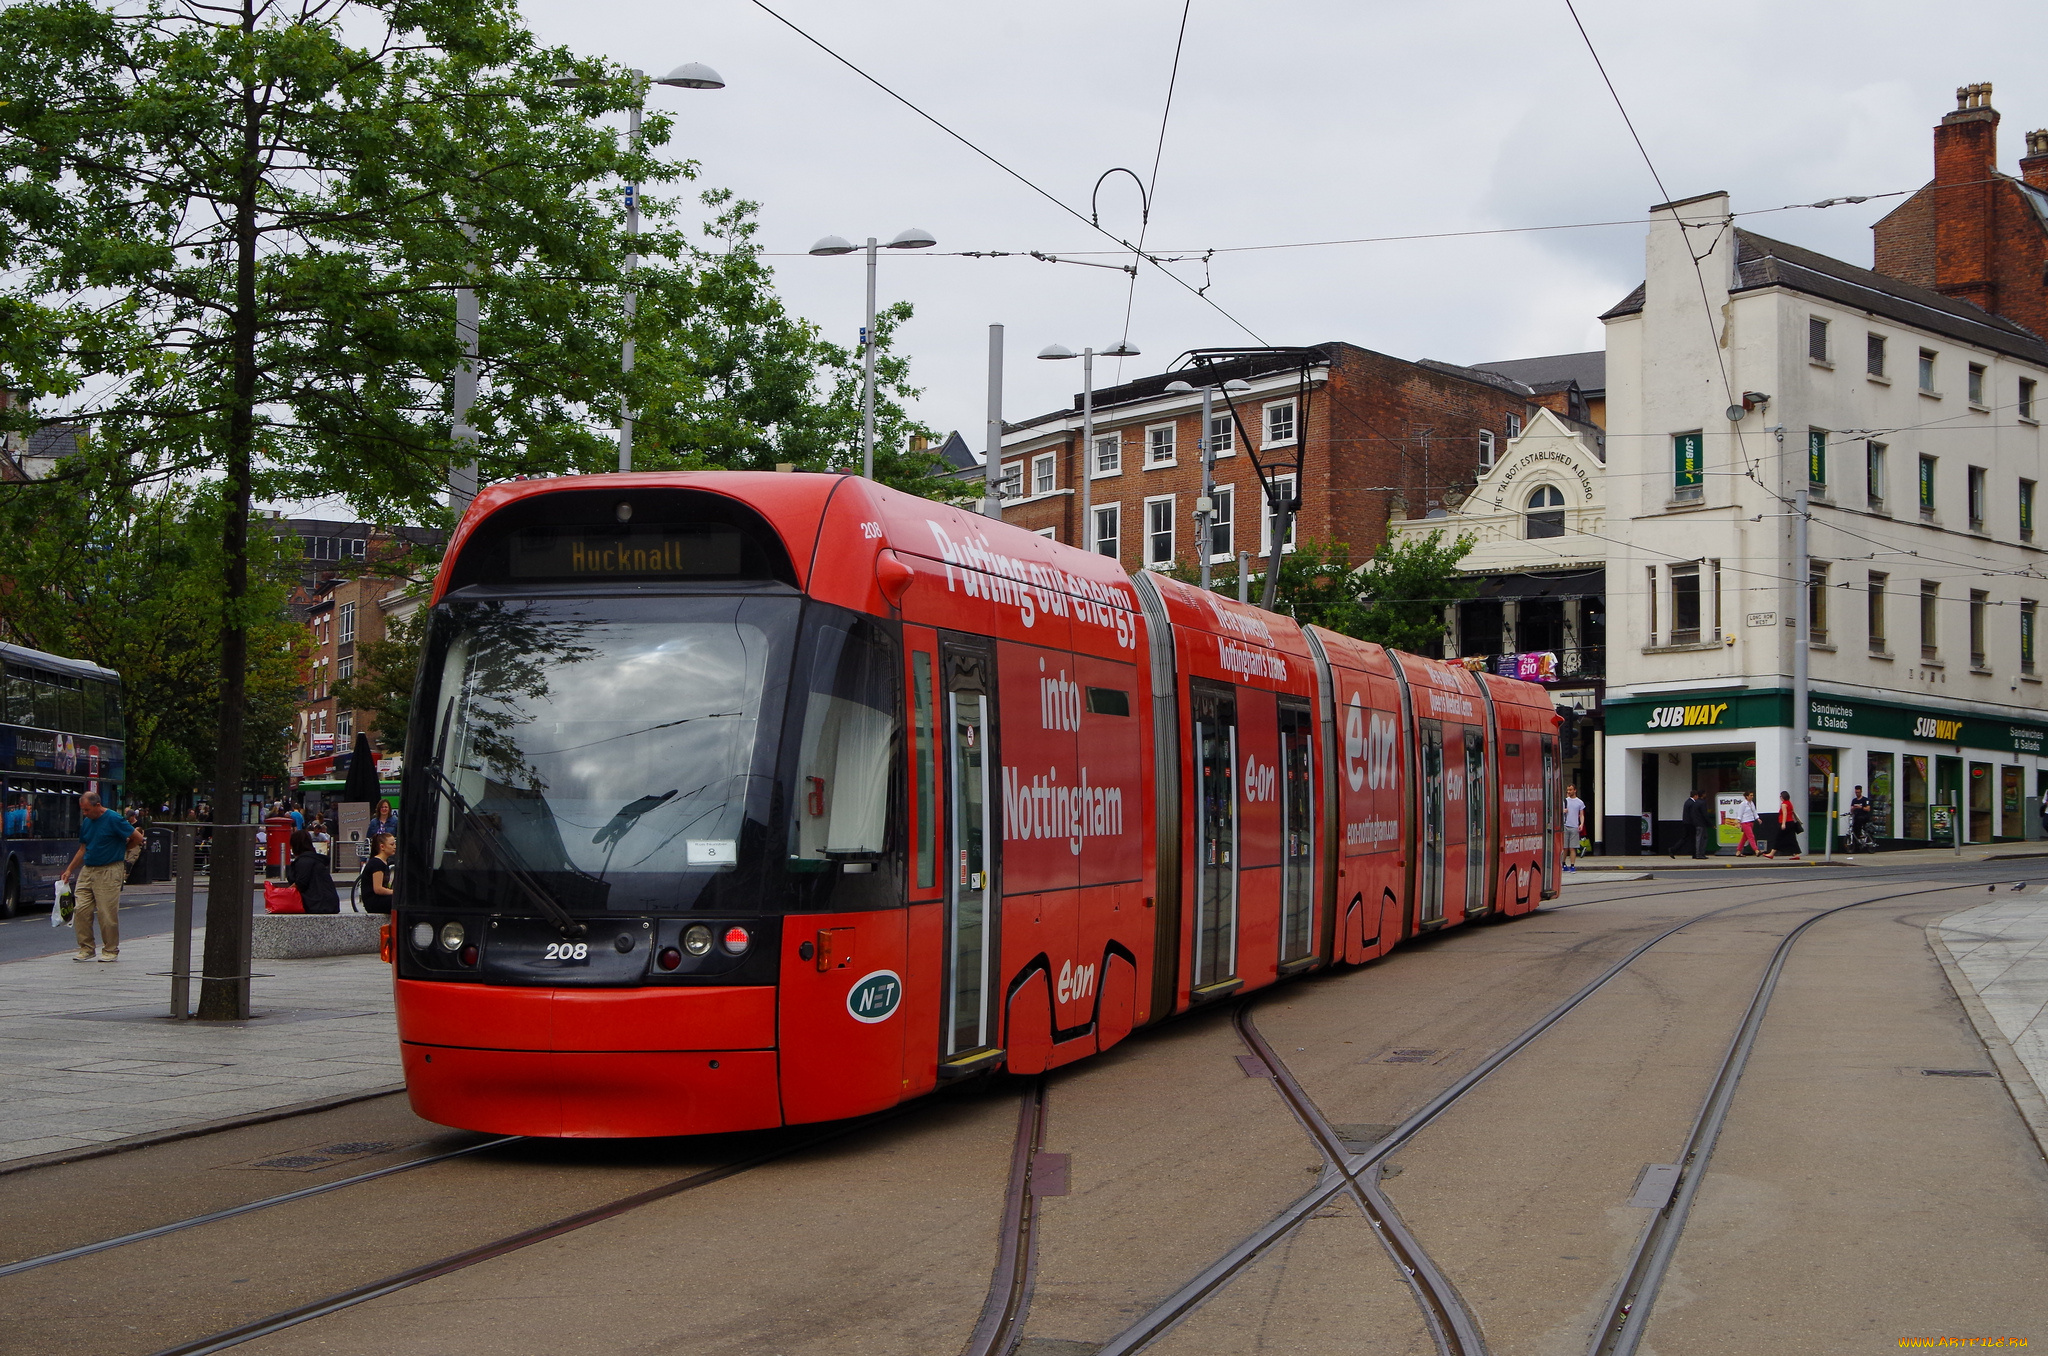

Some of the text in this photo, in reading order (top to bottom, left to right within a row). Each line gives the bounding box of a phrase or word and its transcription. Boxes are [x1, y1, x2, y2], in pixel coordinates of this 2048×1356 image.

[1685, 437, 1694, 483] SUBWAY
[1811, 433, 1819, 481] SUBWAY
[1494, 496, 1503, 512] THE
[1520, 451, 1572, 467] ESTABLISHED
[861, 520, 882, 540] 208
[572, 541, 684, 572] Hucknall
[926, 519, 1137, 650] Putting our energy
[1233, 611, 1275, 649] powering
[1217, 636, 1287, 682] Nottingham's trams
[1521, 663, 1537, 675] £10
[1040, 657, 1081, 732] into
[1647, 702, 1728, 729] SUBWAY
[1811, 701, 1853, 717] Sandwiches
[1817, 716, 1848, 730] & Salads
[1913, 717, 1963, 741] SUBWAY
[2010, 726, 2044, 740] Sandwiches
[2014, 739, 2040, 751] & Salads
[1002, 765, 1123, 856] Nottingham
[708, 848, 716, 856] 8
[544, 942, 589, 961] 208
[858, 983, 895, 1012] NET
